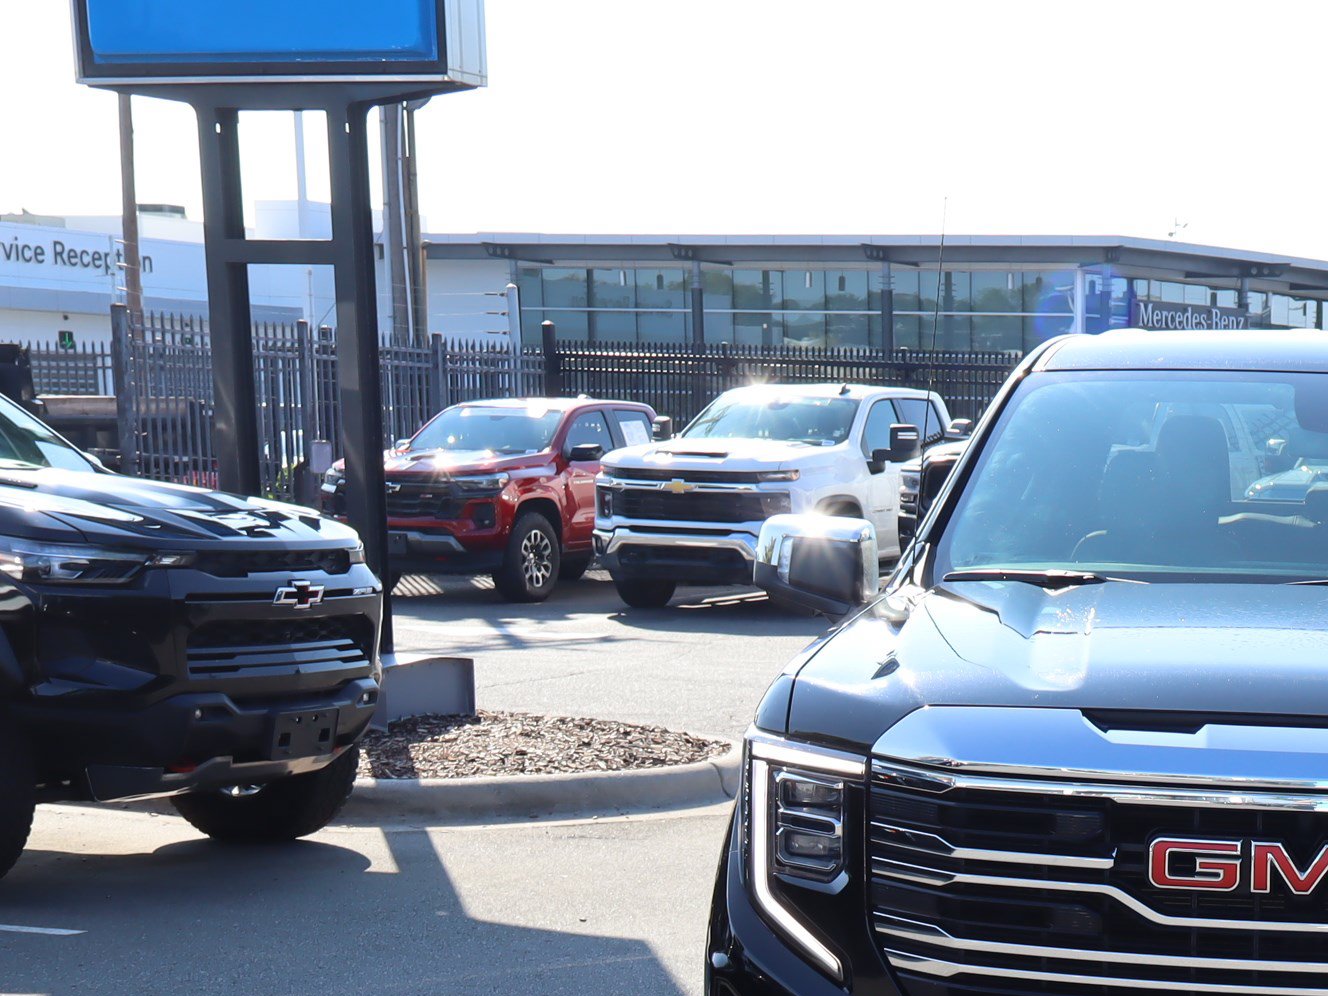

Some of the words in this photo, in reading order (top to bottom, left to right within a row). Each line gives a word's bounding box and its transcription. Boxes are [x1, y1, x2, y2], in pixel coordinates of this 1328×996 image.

[0, 236, 46, 264] vice
[53, 240, 153, 275] Receptn
[1138, 302, 1244, 329] Mercedes-Benz
